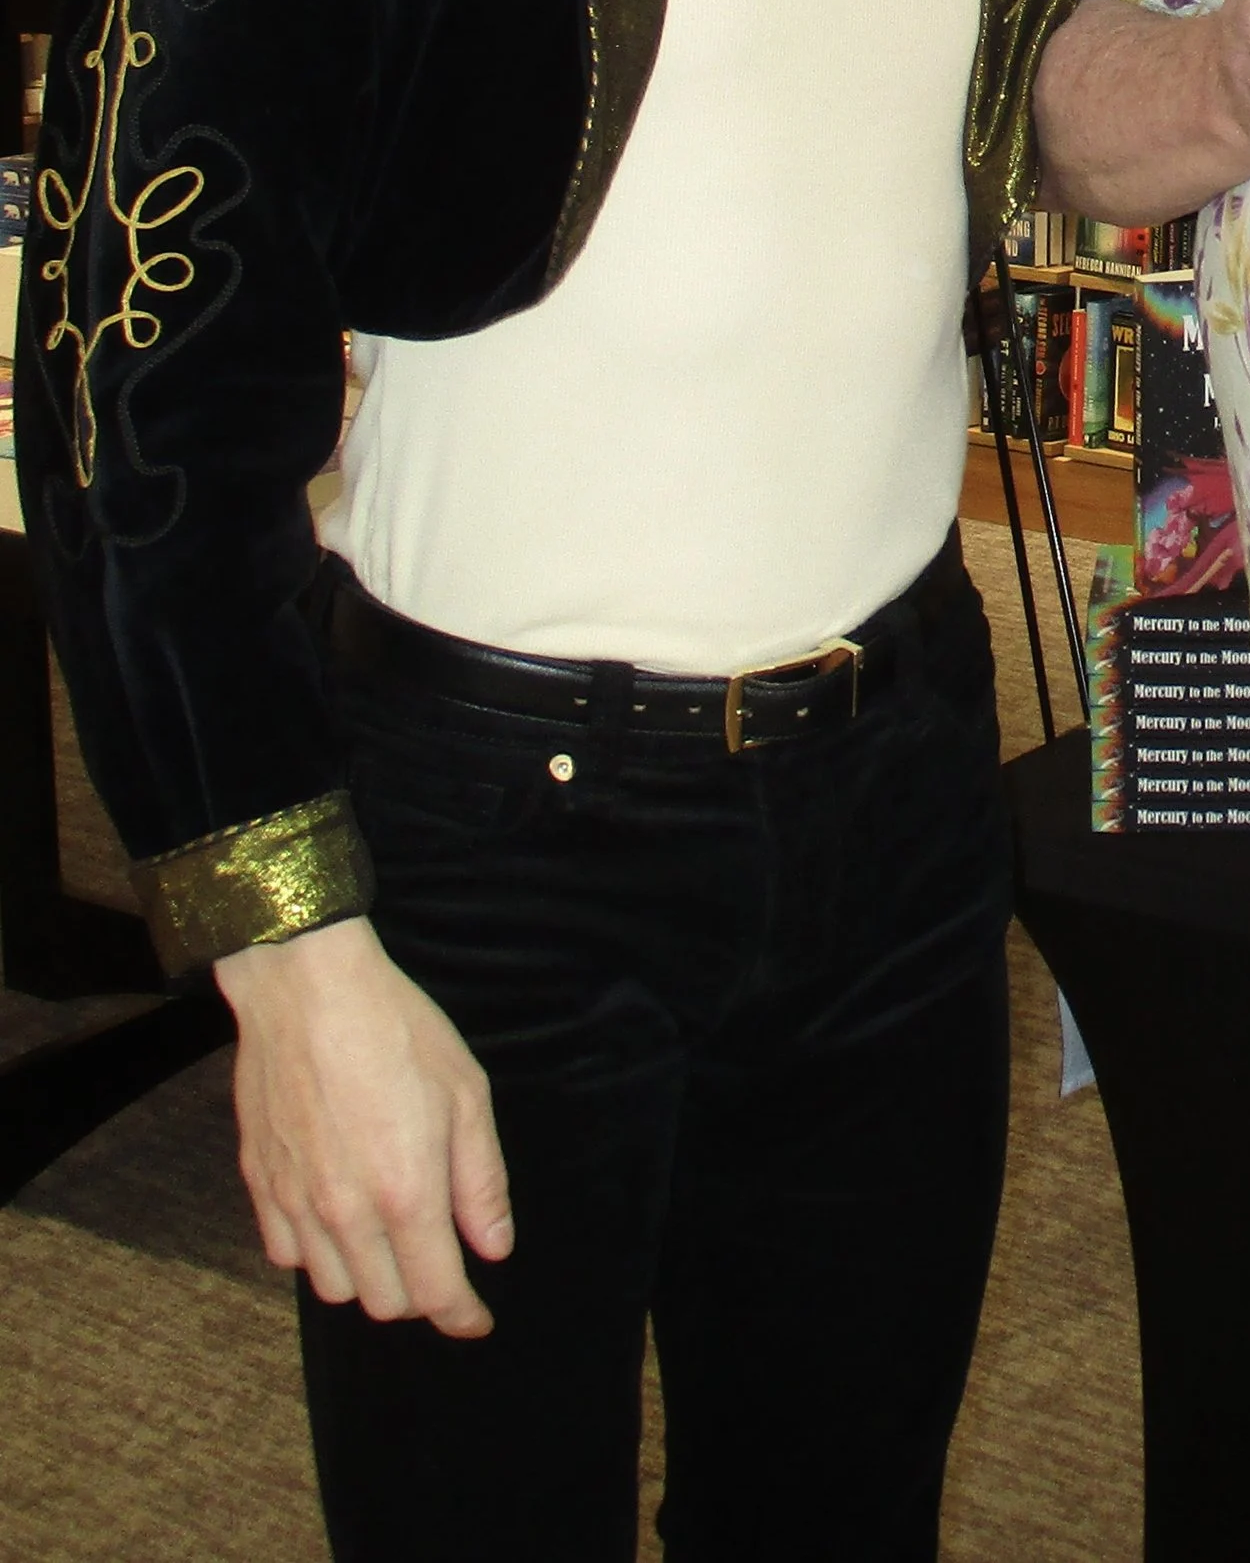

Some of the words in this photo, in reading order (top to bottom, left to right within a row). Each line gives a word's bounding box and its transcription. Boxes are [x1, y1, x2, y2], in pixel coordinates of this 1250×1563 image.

[1133, 616, 1184, 632] Mercury
[1188, 619, 1199, 631] to
[1202, 619, 1220, 631] the
[1131, 649, 1182, 665] Mercury
[1186, 652, 1197, 664] to
[1200, 651, 1218, 664] the
[1134, 684, 1185, 700] Mercury
[1189, 686, 1200, 698] to
[1203, 685, 1221, 698] the
[1136, 715, 1186, 731] Mercury
[1191, 717, 1201, 730] to
[1205, 716, 1222, 730] the
[1137, 748, 1188, 764] Mercury
[1192, 750, 1202, 762] to
[1206, 749, 1224, 762] the
[1138, 778, 1188, 794] Mercury
[1193, 780, 1203, 792] to
[1206, 779, 1224, 792] the
[1137, 809, 1188, 826] Mercury
[1192, 811, 1202, 823] to
[1206, 810, 1223, 823] the
